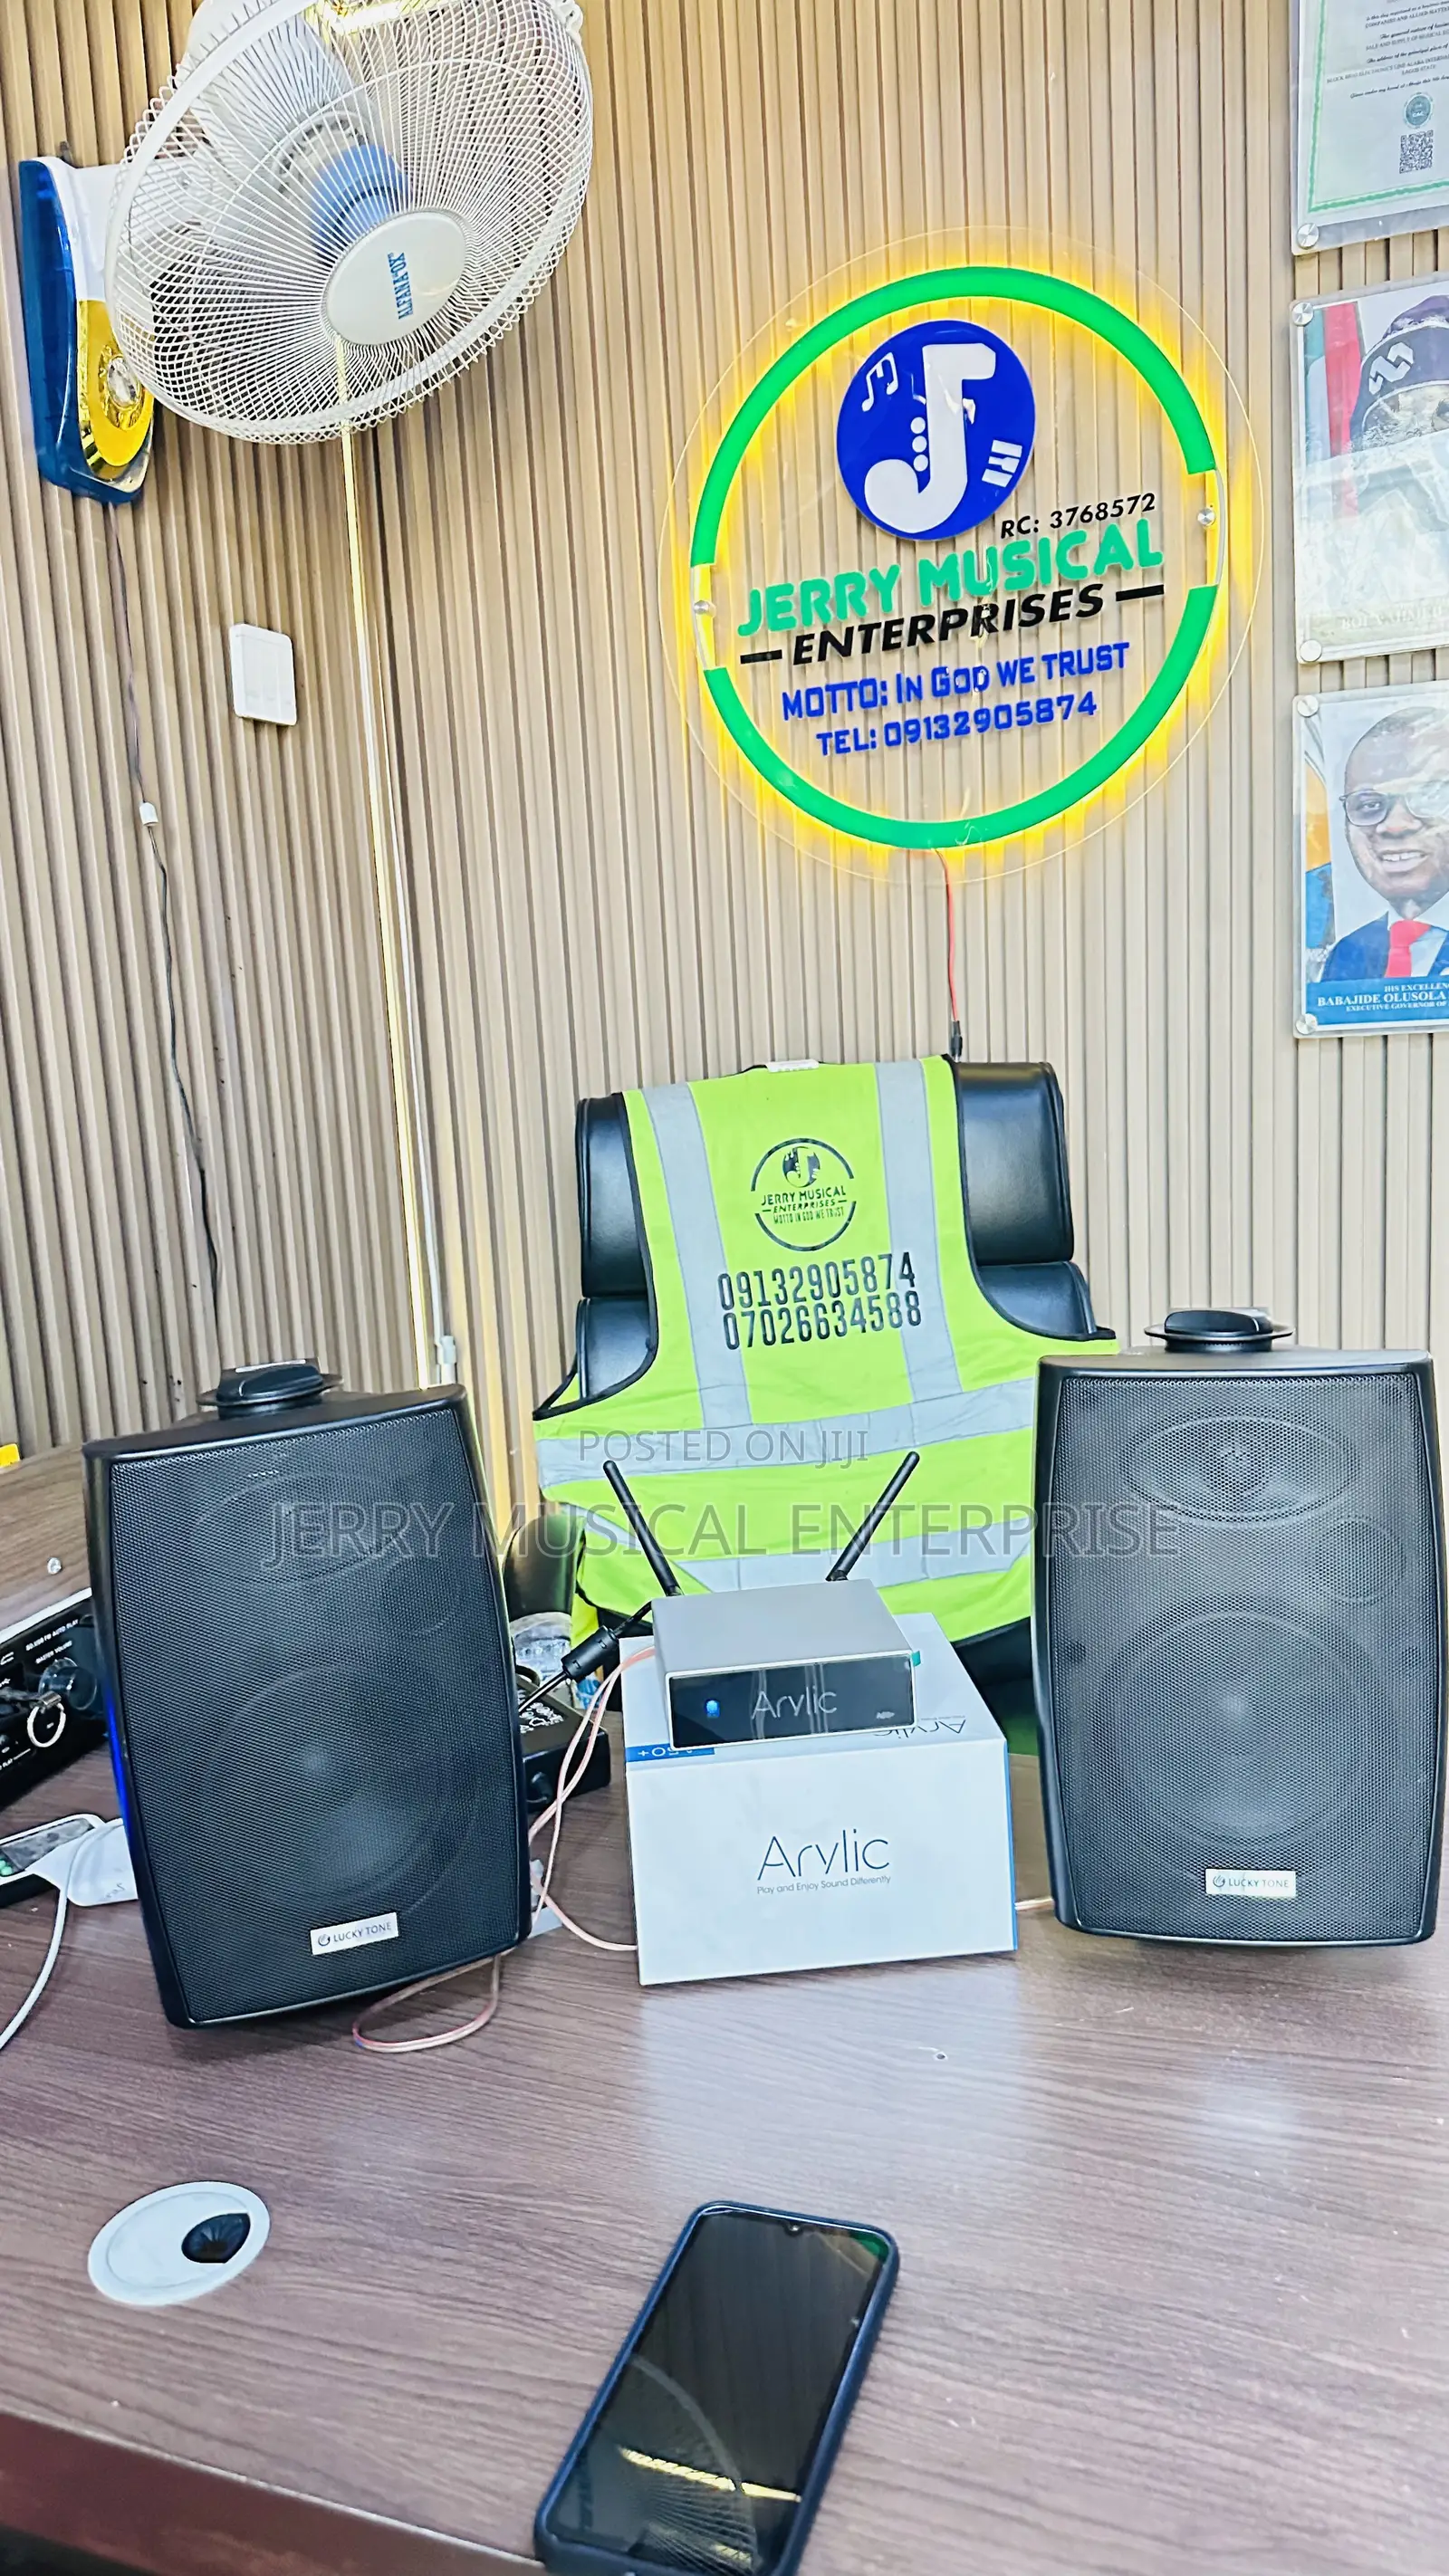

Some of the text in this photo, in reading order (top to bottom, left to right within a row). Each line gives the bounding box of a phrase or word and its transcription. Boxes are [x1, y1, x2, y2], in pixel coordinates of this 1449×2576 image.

[1000, 493, 1156, 540] RC: 3768572
[736, 517, 1165, 637] JERRY MUSICAL
[792, 583, 1104, 666] ENTERPRISES
[782, 677, 888, 721] MOTTO:
[997, 656, 1035, 687] WE
[1041, 642, 1130, 680] TRUST
[816, 691, 1098, 756] TEL: 09132905874
[1318, 991, 1447, 1007] BABAJIDE OLUSOLA
[1401, 982, 1449, 991] EXCELLEN
[1346, 1003, 1391, 1012] EXECUTIVE
[1391, 1001, 1435, 1010] GOVERNOR
[761, 1185, 847, 1206] JERRY MUSICAL
[773, 1199, 836, 1213] ENTERPRISES
[717, 1251, 916, 1311] 09132905874
[723, 1290, 922, 1351] 07026634588
[751, 1685, 838, 1719] Arylic
[757, 1828, 889, 1881] Arylic
[757, 1875, 891, 1895] Play and Enjoy Sound Differently
[1228, 1878, 1290, 1888] LUCKY TONE
[333, 1921, 391, 1942] LUCKY TONE
